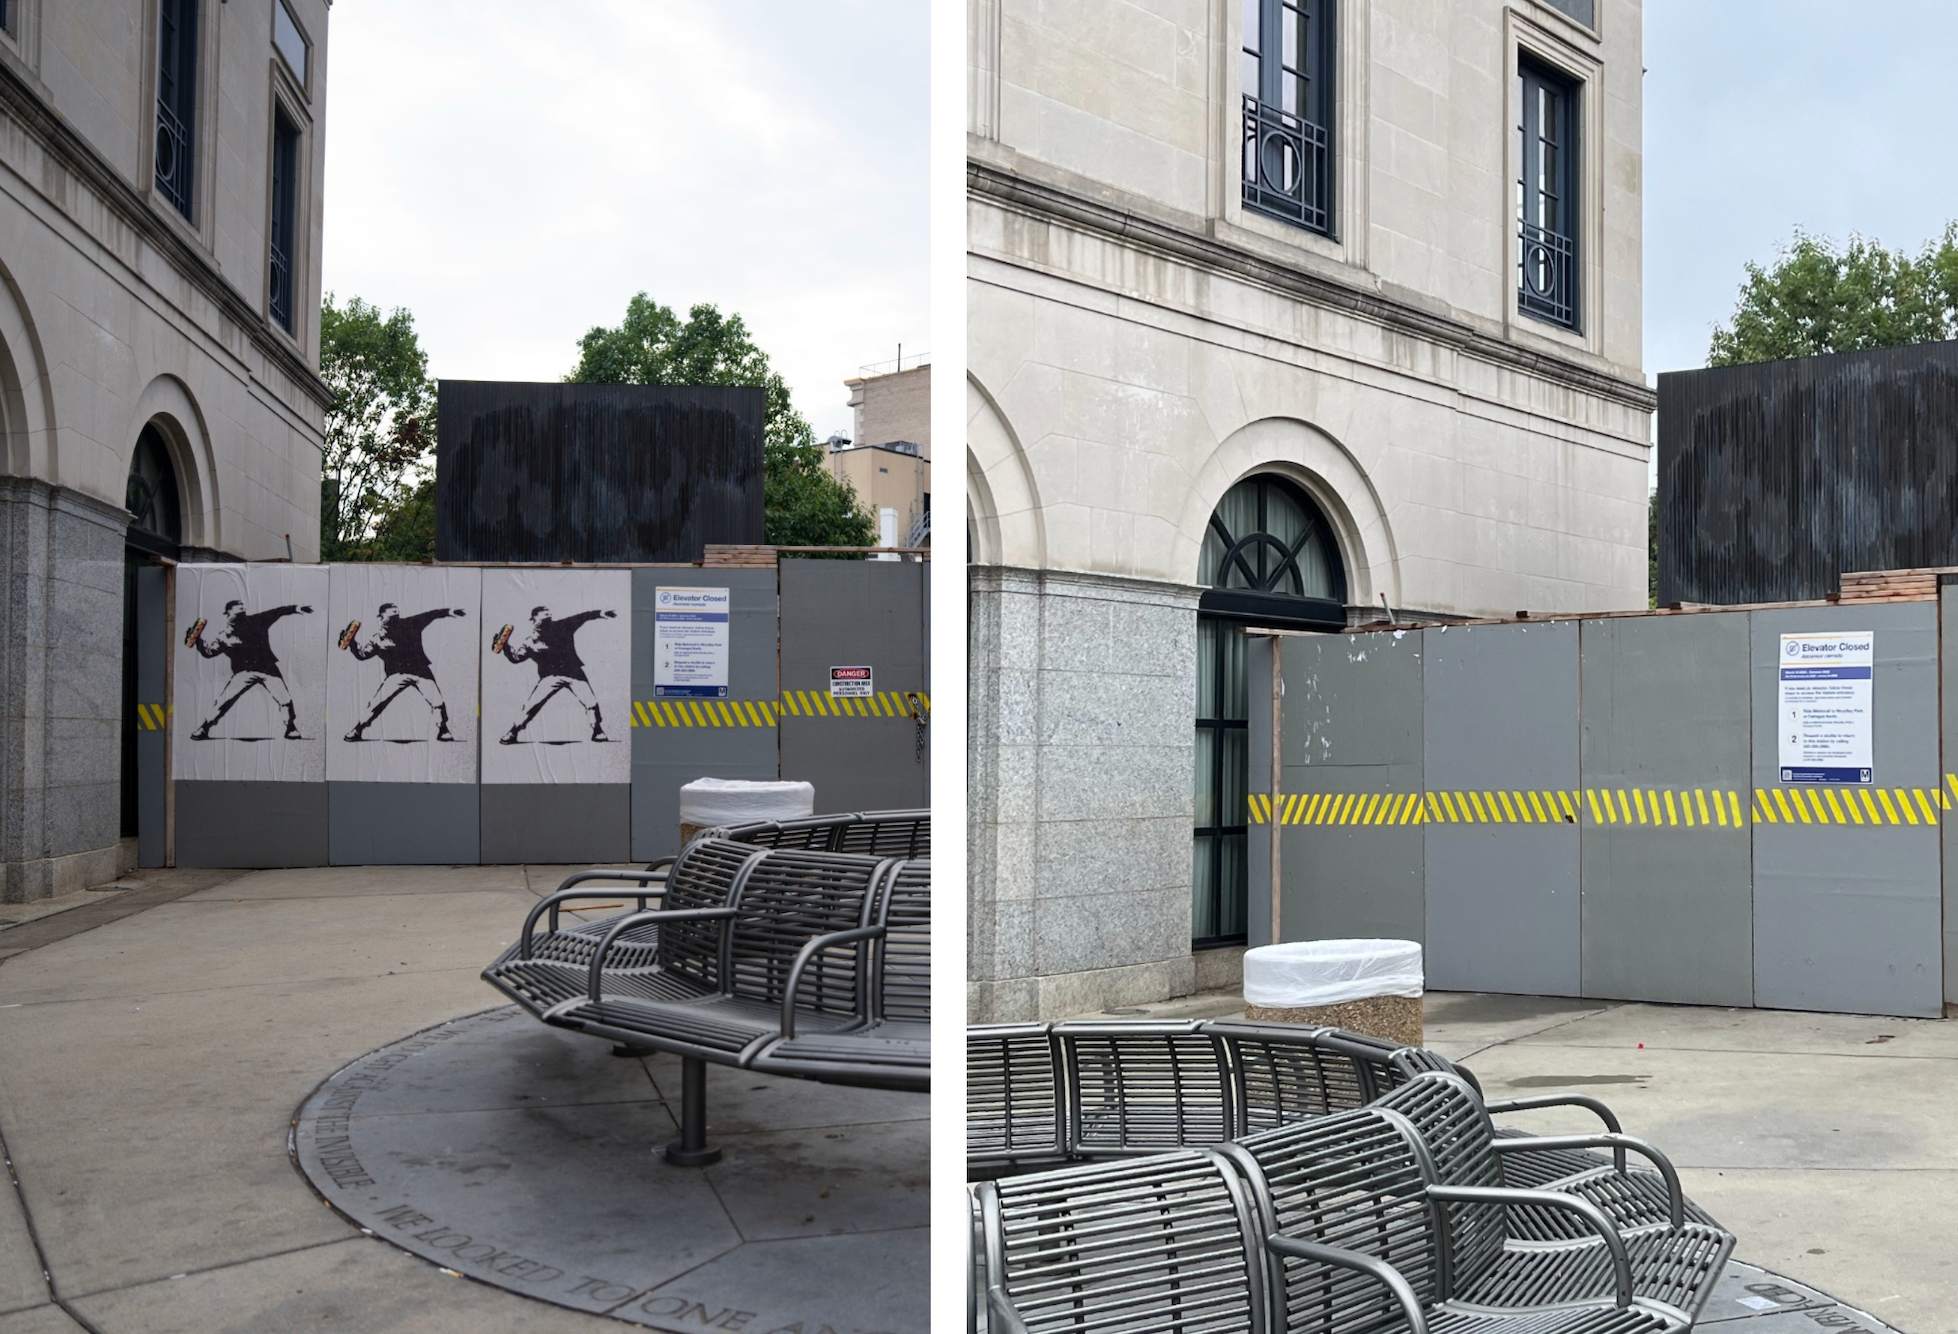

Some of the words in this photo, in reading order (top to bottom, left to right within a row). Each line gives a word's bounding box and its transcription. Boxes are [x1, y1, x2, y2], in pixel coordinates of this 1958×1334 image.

[1802, 643, 1837, 652] Elevator
[1839, 642, 1870, 651] Closed
[1791, 735, 1797, 743] 2
[1861, 770, 1869, 778] M
[320, 1073, 378, 1116] AGAINST
[315, 1113, 350, 1134] THE
[315, 1135, 376, 1190] INVISIBLE
[373, 1204, 434, 1231] WE
[412, 1226, 566, 1283] LOOKED
[564, 1275, 637, 1301] TO
[640, 1296, 757, 1331] ONE
